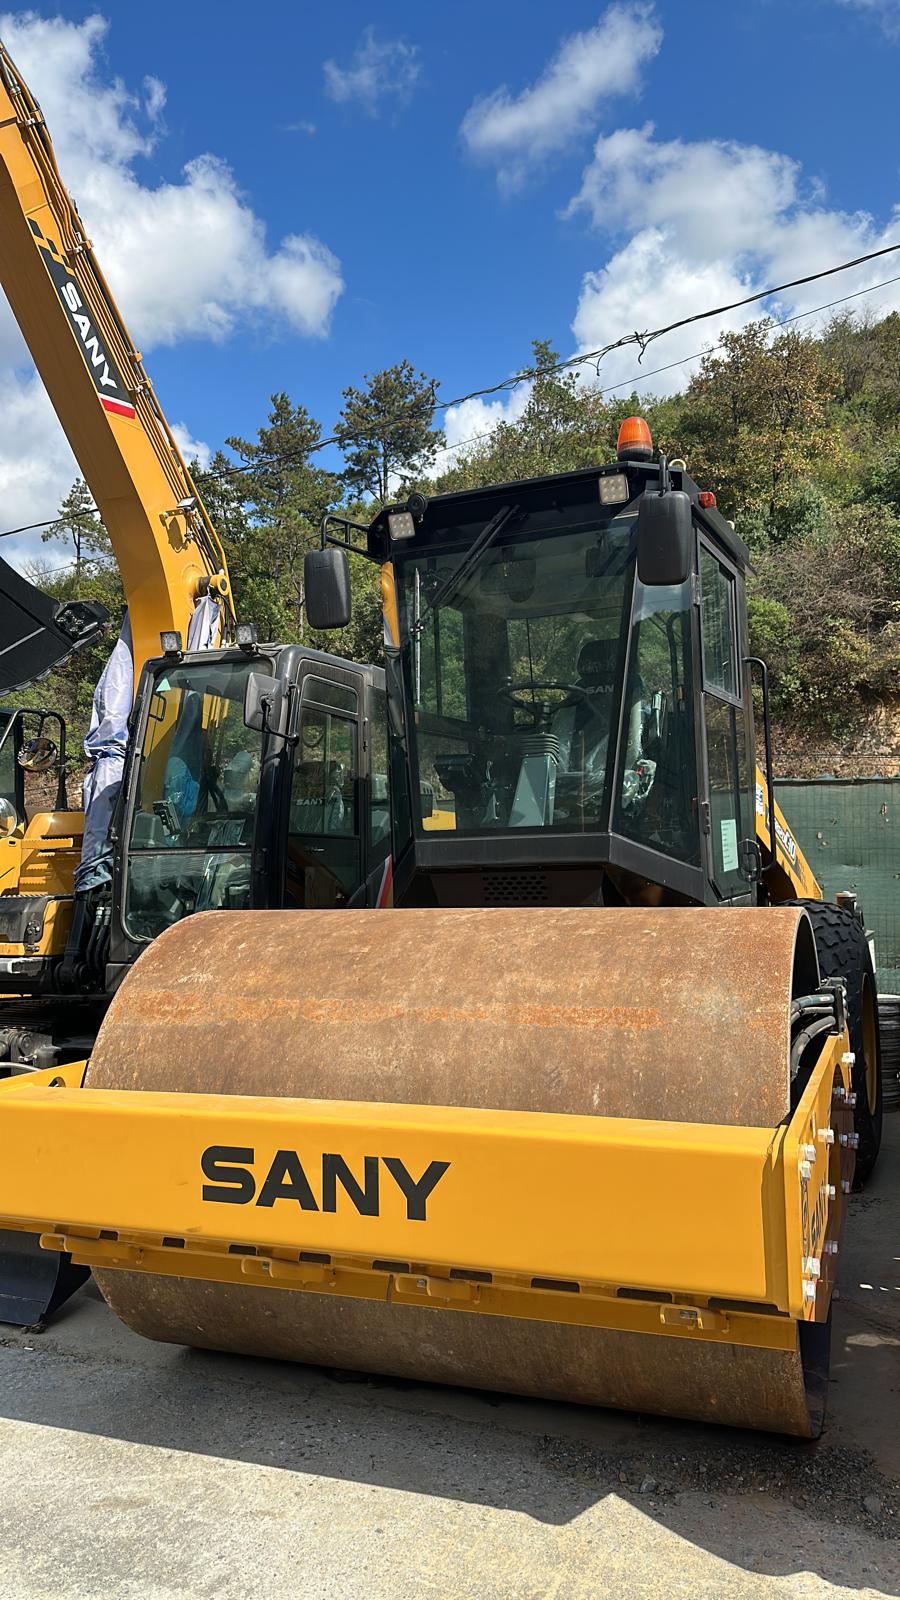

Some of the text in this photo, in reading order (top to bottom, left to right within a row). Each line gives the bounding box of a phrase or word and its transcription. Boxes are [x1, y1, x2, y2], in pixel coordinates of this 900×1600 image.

[61, 282, 117, 388] SANY
[585, 684, 614, 694] SAN
[201, 1145, 451, 1221] SANY
